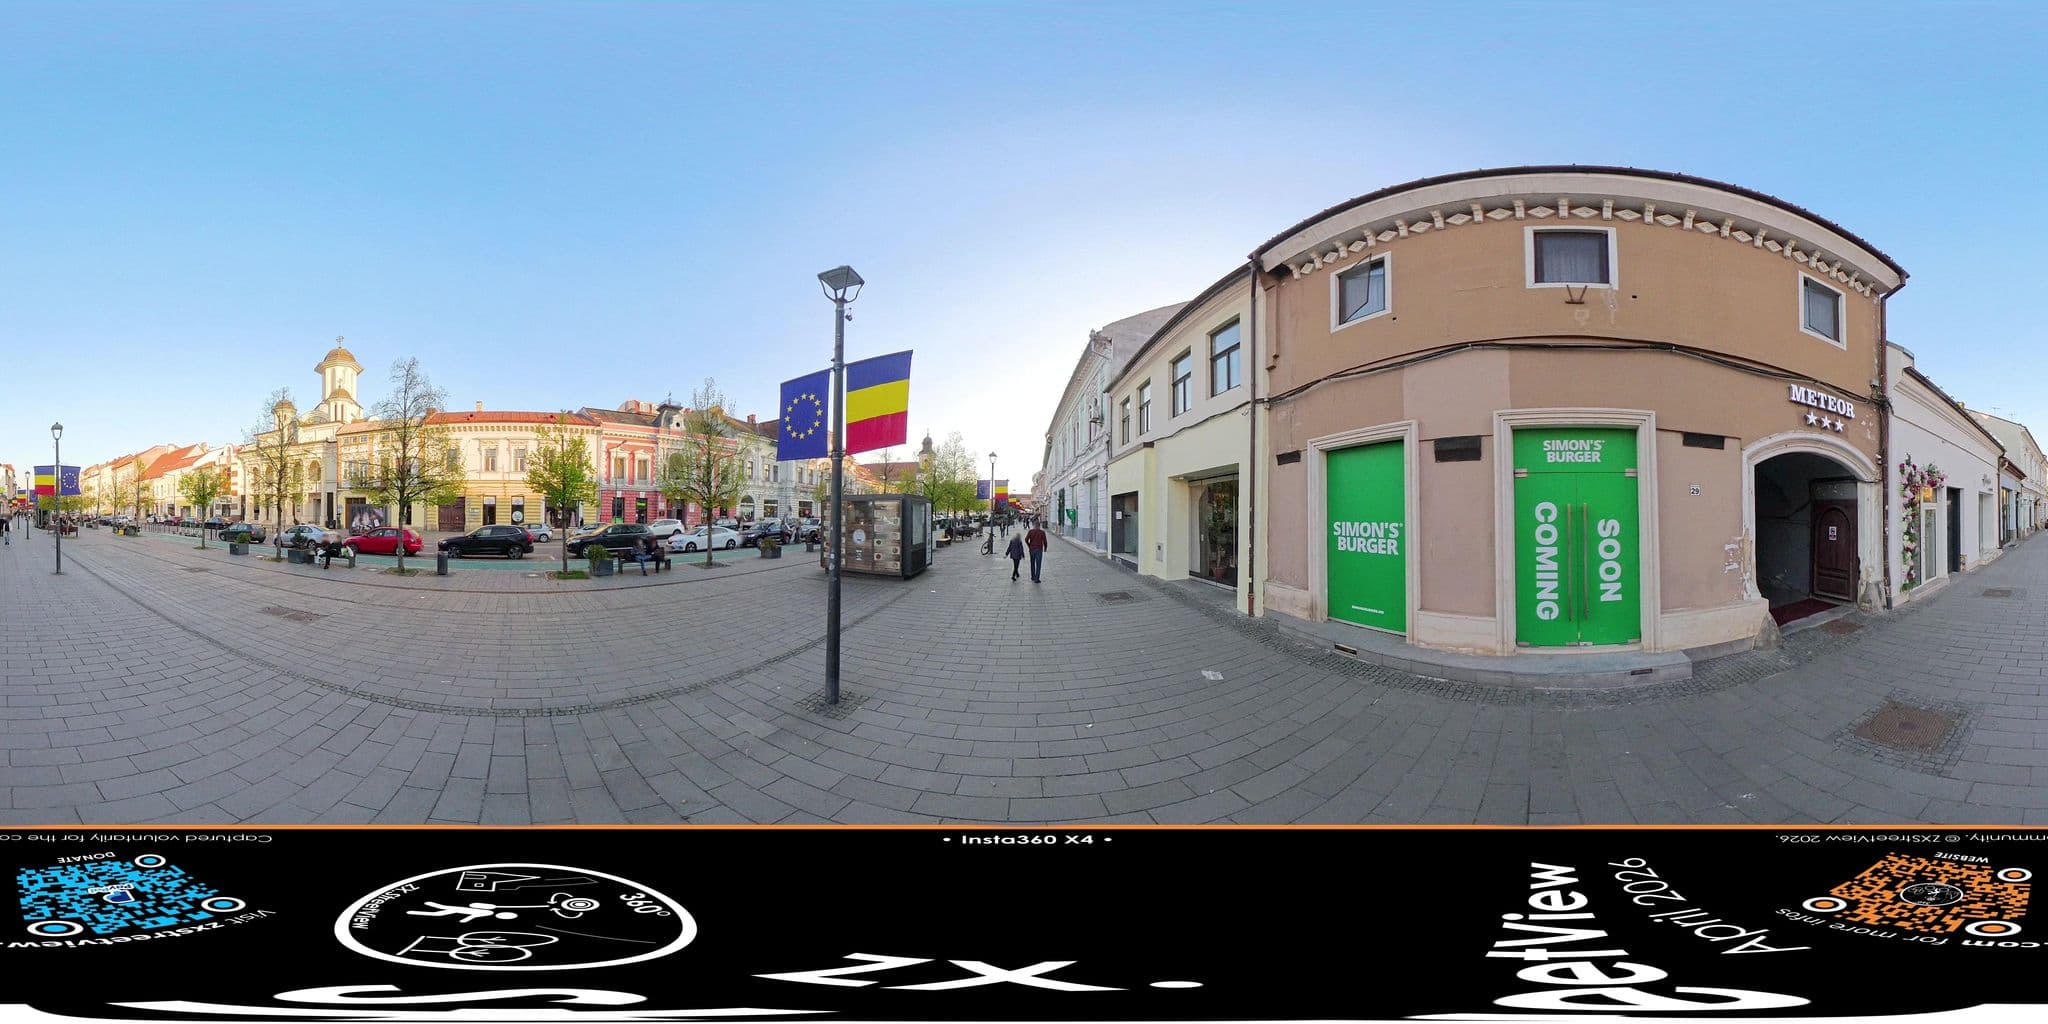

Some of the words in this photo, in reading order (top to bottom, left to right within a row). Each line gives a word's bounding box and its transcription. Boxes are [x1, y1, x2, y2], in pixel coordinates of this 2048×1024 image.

[1790, 384, 1855, 418] METEOR
[1547, 451, 1601, 463] BURGER
[1338, 536, 1399, 555] BURGER
[1535, 501, 1559, 621] COMING
[1597, 519, 1622, 602] SOON
